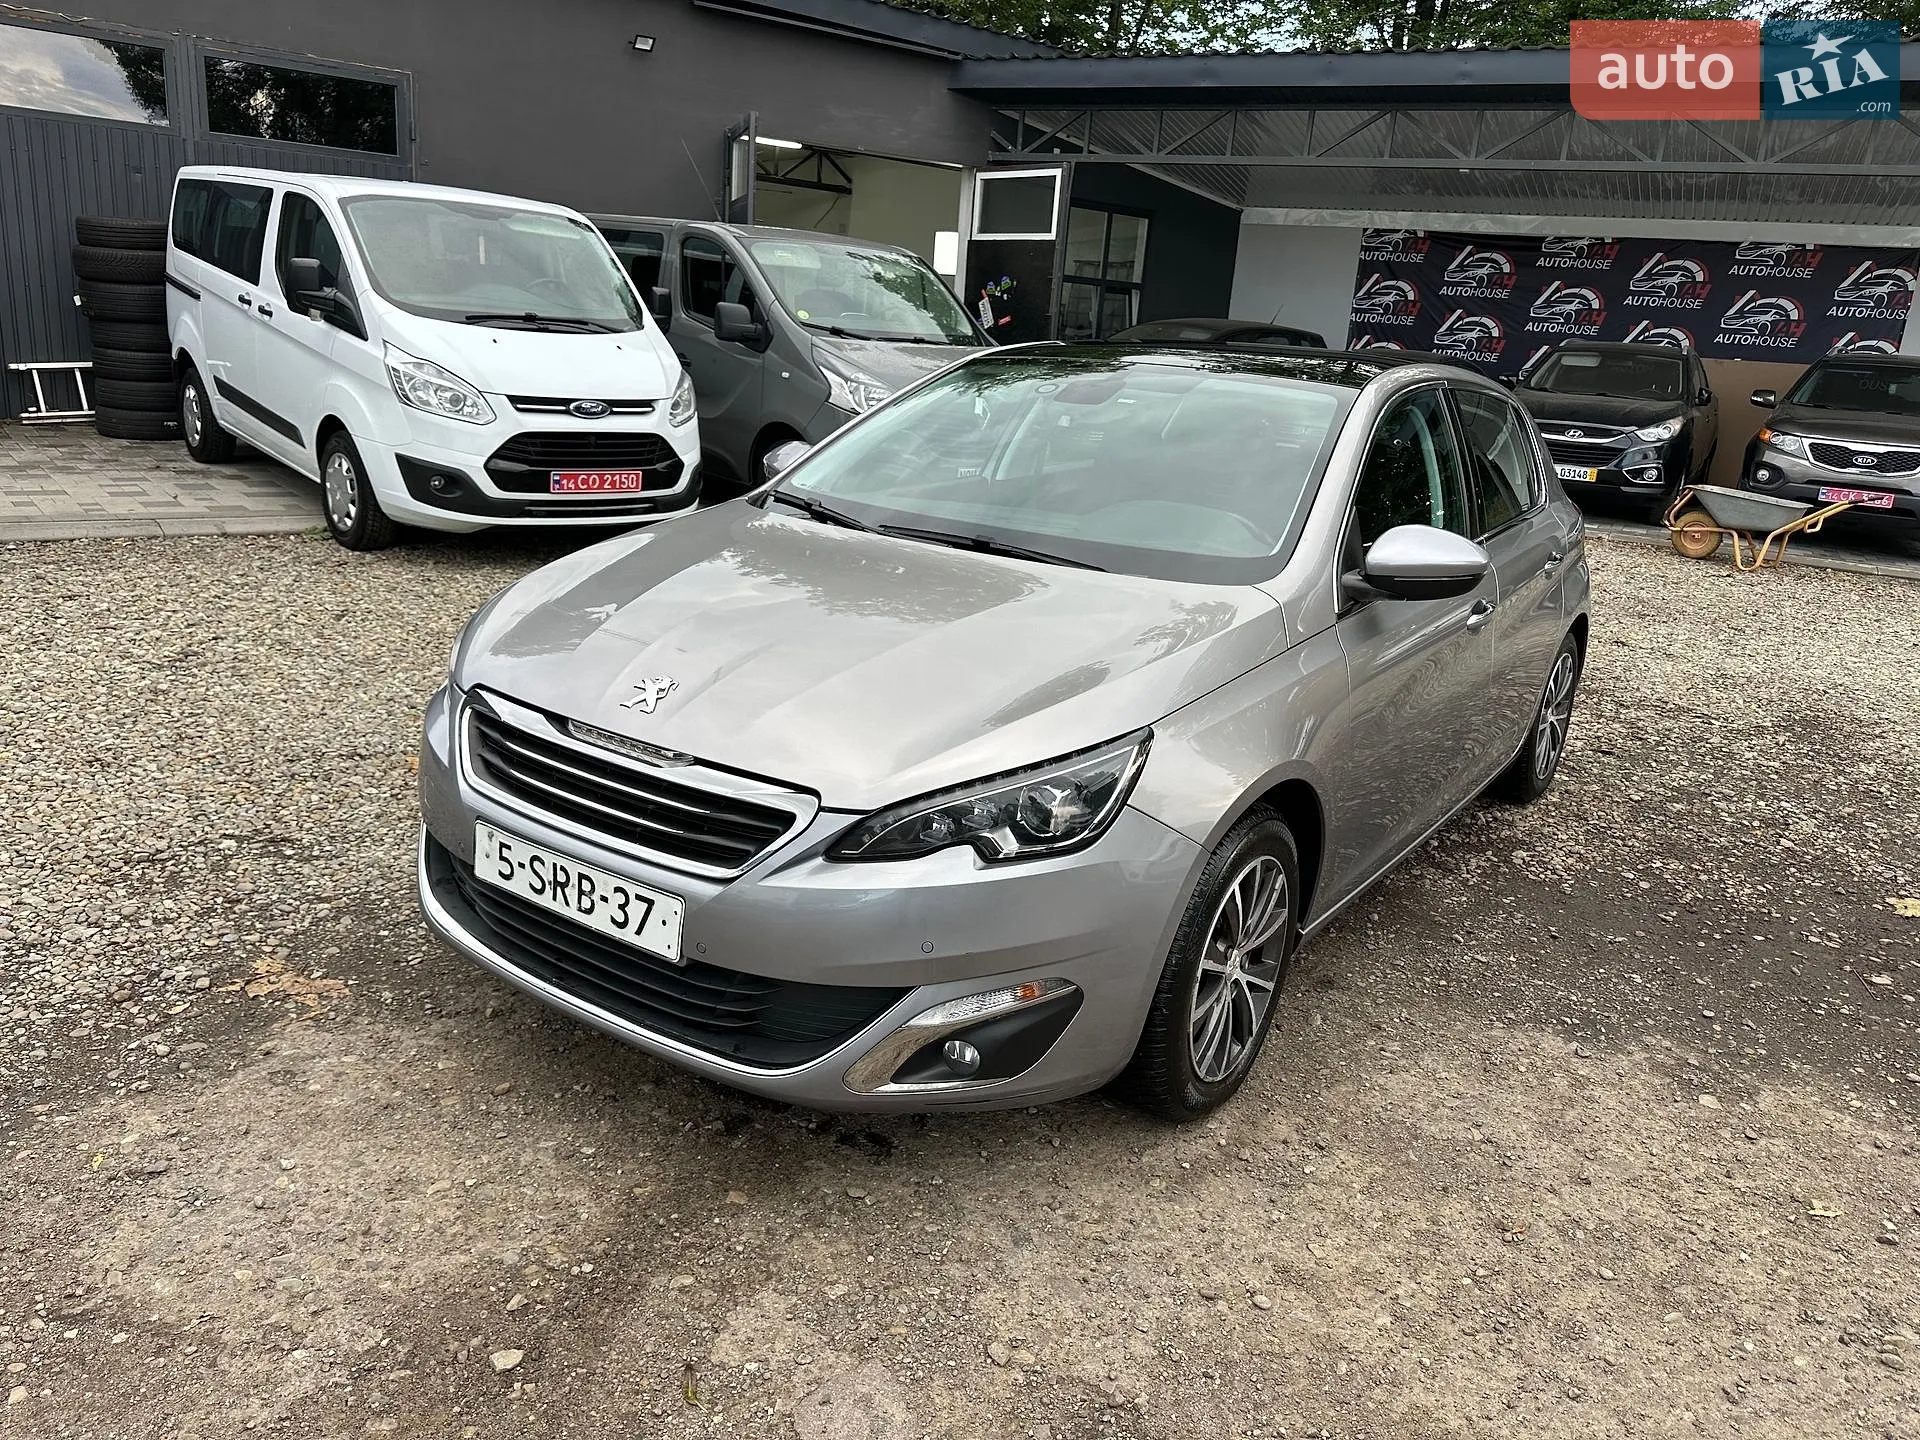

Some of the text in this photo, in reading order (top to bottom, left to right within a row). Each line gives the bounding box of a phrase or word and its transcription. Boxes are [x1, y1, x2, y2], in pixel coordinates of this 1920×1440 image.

[1359, 251, 1425, 263] AUTOHOUSE
[1536, 256, 1613, 270] AUTOHOUSE
[1728, 264, 1815, 278] AUTOHOUSE
[1438, 286, 1511, 299] AUTOHOUSE
[1623, 295, 1704, 309] AUTOHOUSE
[1349, 313, 1416, 326] AUTOHOUSE
[1524, 321, 1600, 336] AUTOHOUSE
[1713, 332, 1801, 348] AUTOHOUSE
[1560, 468, 1588, 479] 03148
[561, 479, 575, 490] 14
[578, 474, 600, 489] CO
[603, 474, 637, 489] 2150
[1840, 491, 1856, 501] CK
[497, 841, 656, 936] 5-SRB-37
